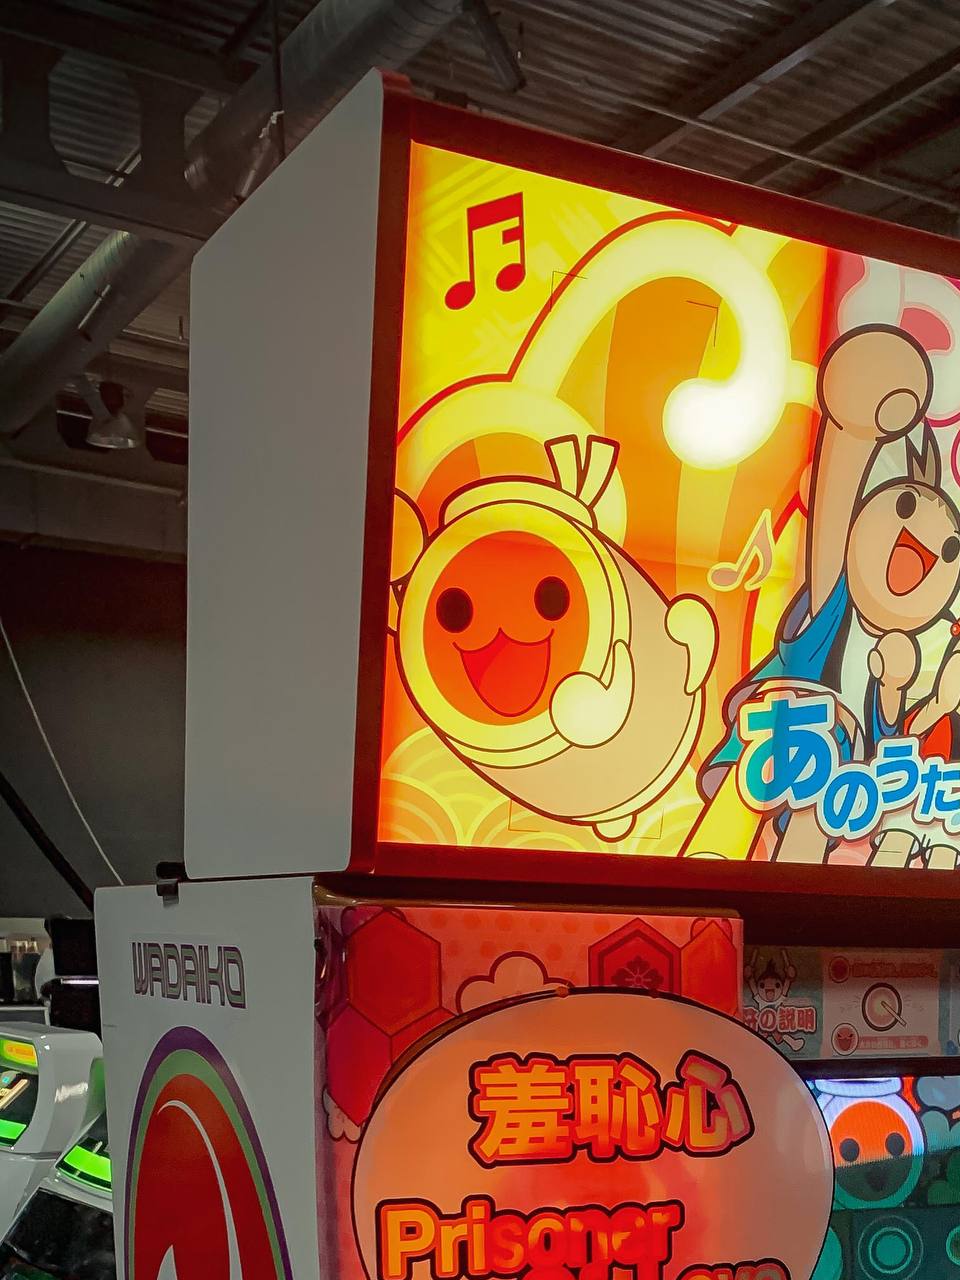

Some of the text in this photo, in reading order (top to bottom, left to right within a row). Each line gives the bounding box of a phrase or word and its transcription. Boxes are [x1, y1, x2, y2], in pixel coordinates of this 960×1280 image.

[131, 941, 248, 1010] WADAIKO
[468, 1048, 755, 1169] 羞恥心
